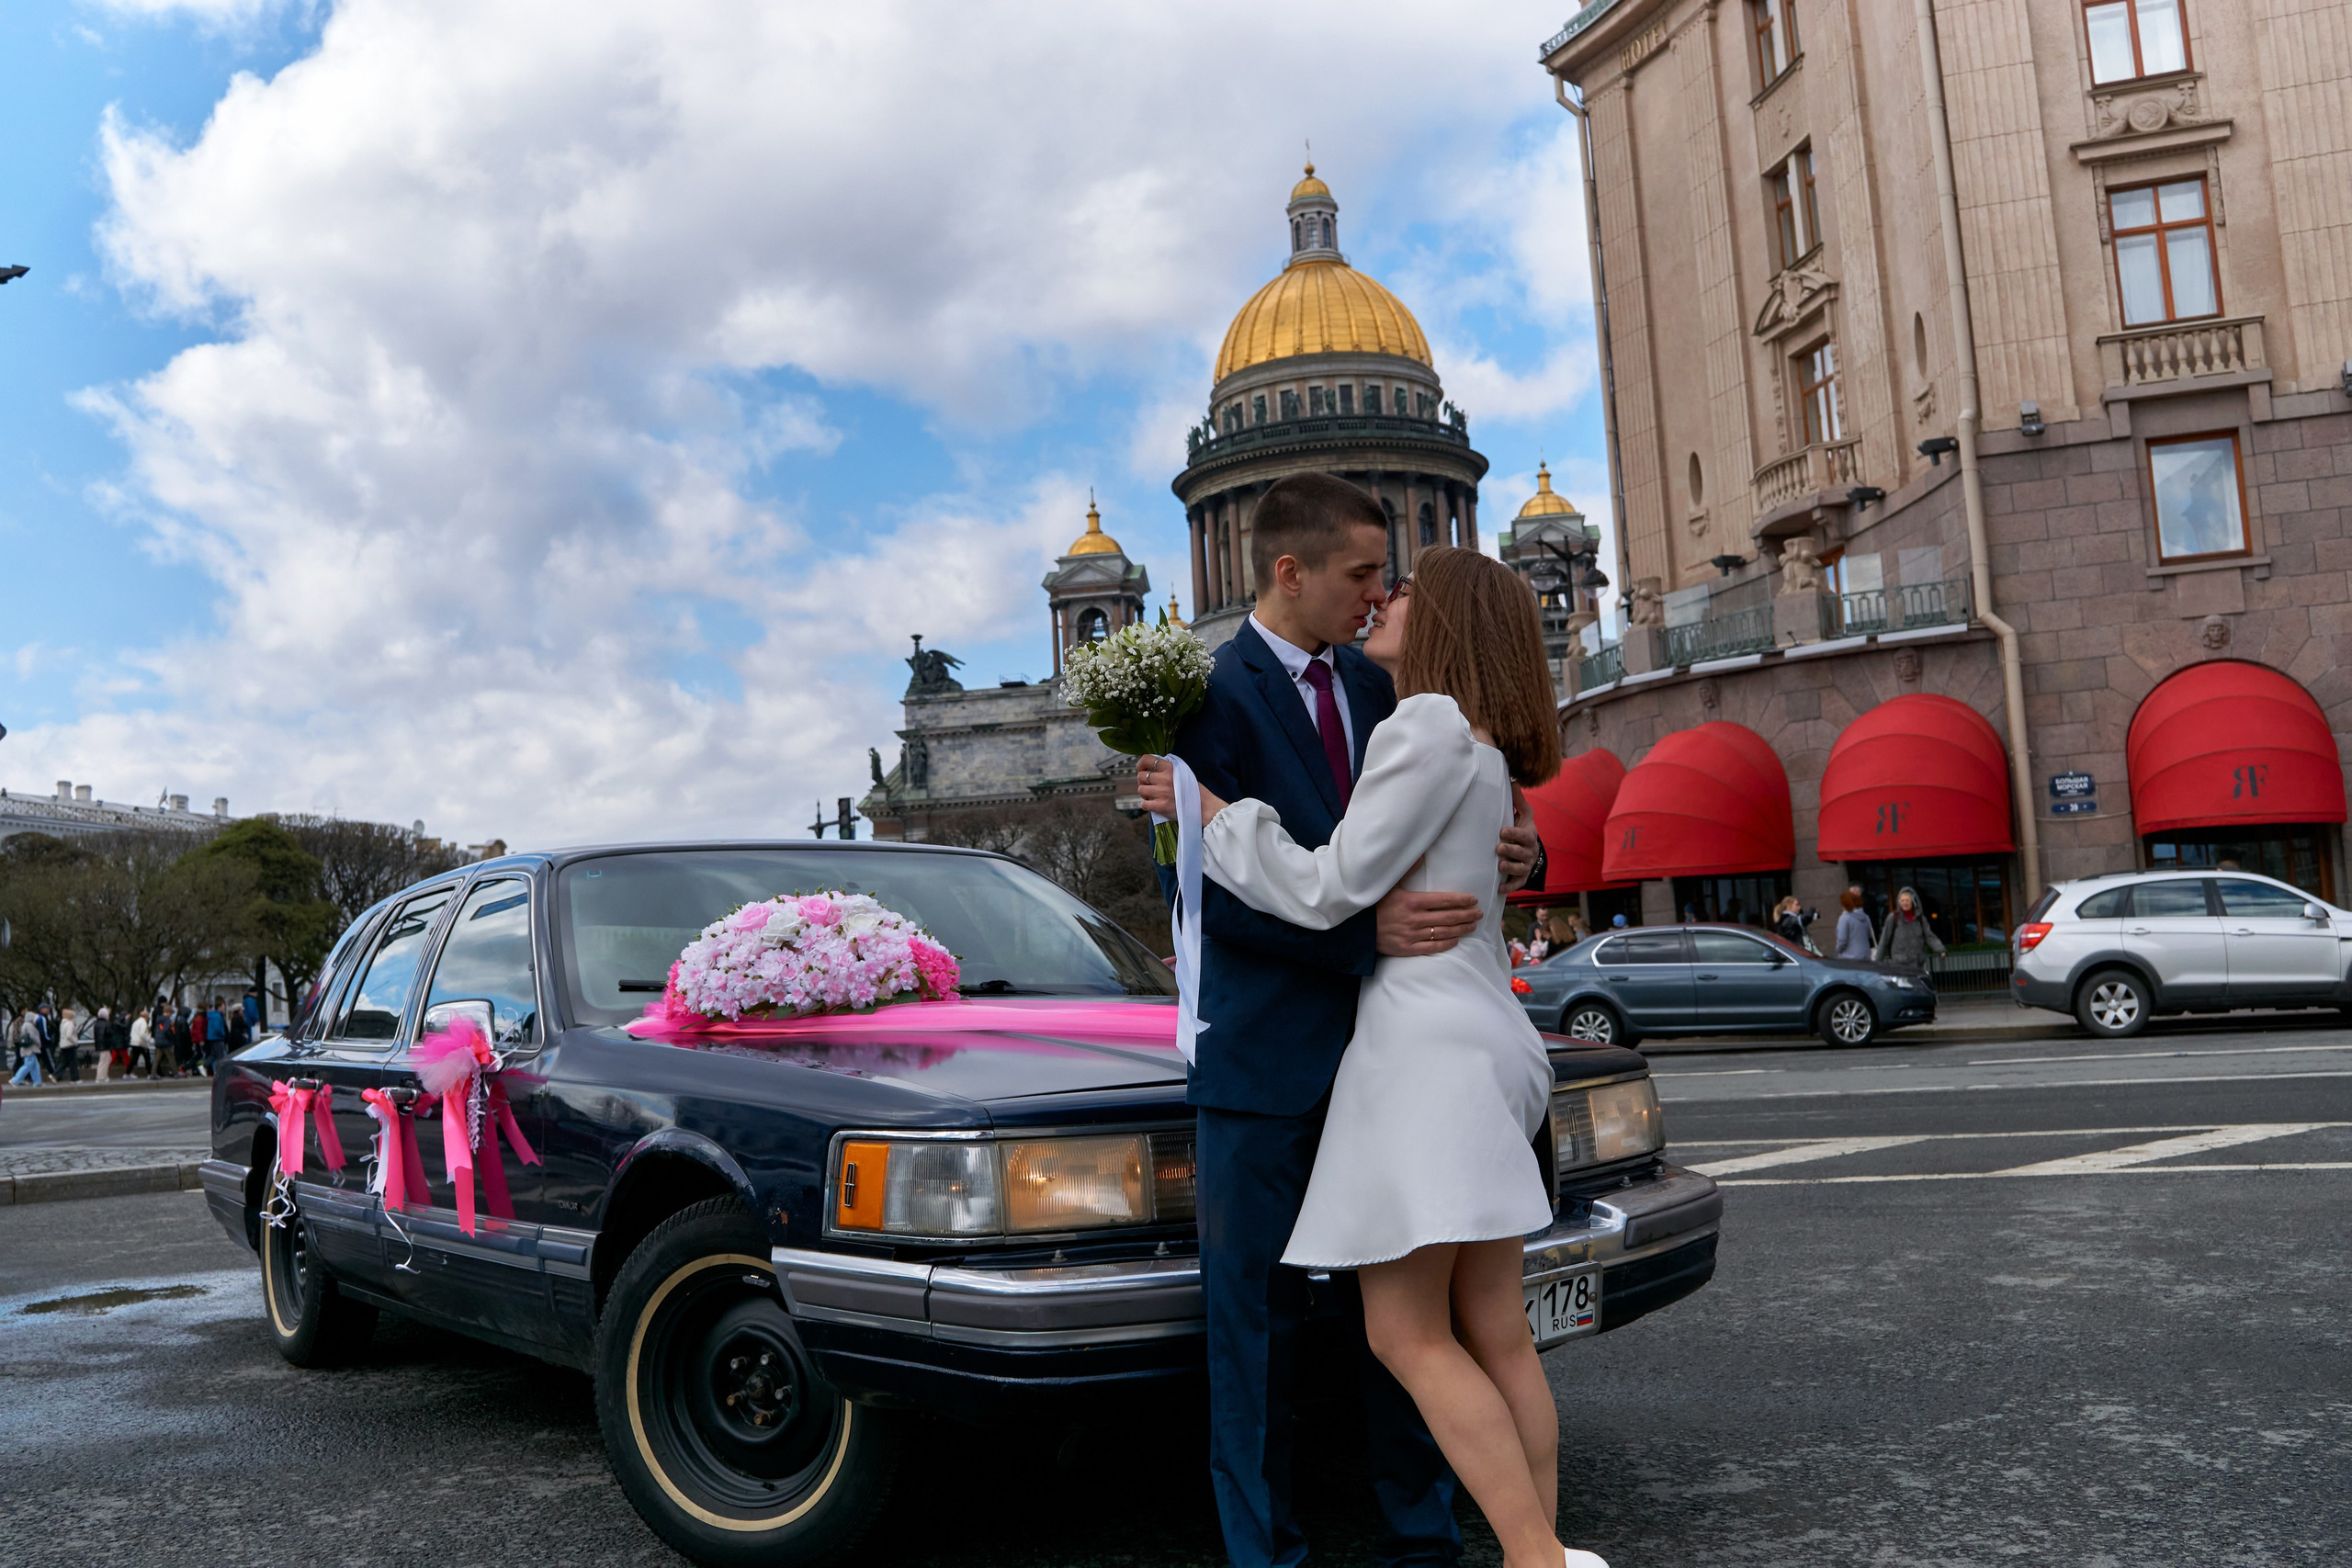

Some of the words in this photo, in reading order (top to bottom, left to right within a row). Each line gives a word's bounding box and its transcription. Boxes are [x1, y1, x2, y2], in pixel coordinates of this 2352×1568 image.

[2055, 776, 2089, 784] БОЛЬШАЯ
[2056, 783, 2088, 791] МОРСКАЯ
[1543, 1275, 1589, 1317] 178
[1552, 1314, 1577, 1332] RUS
